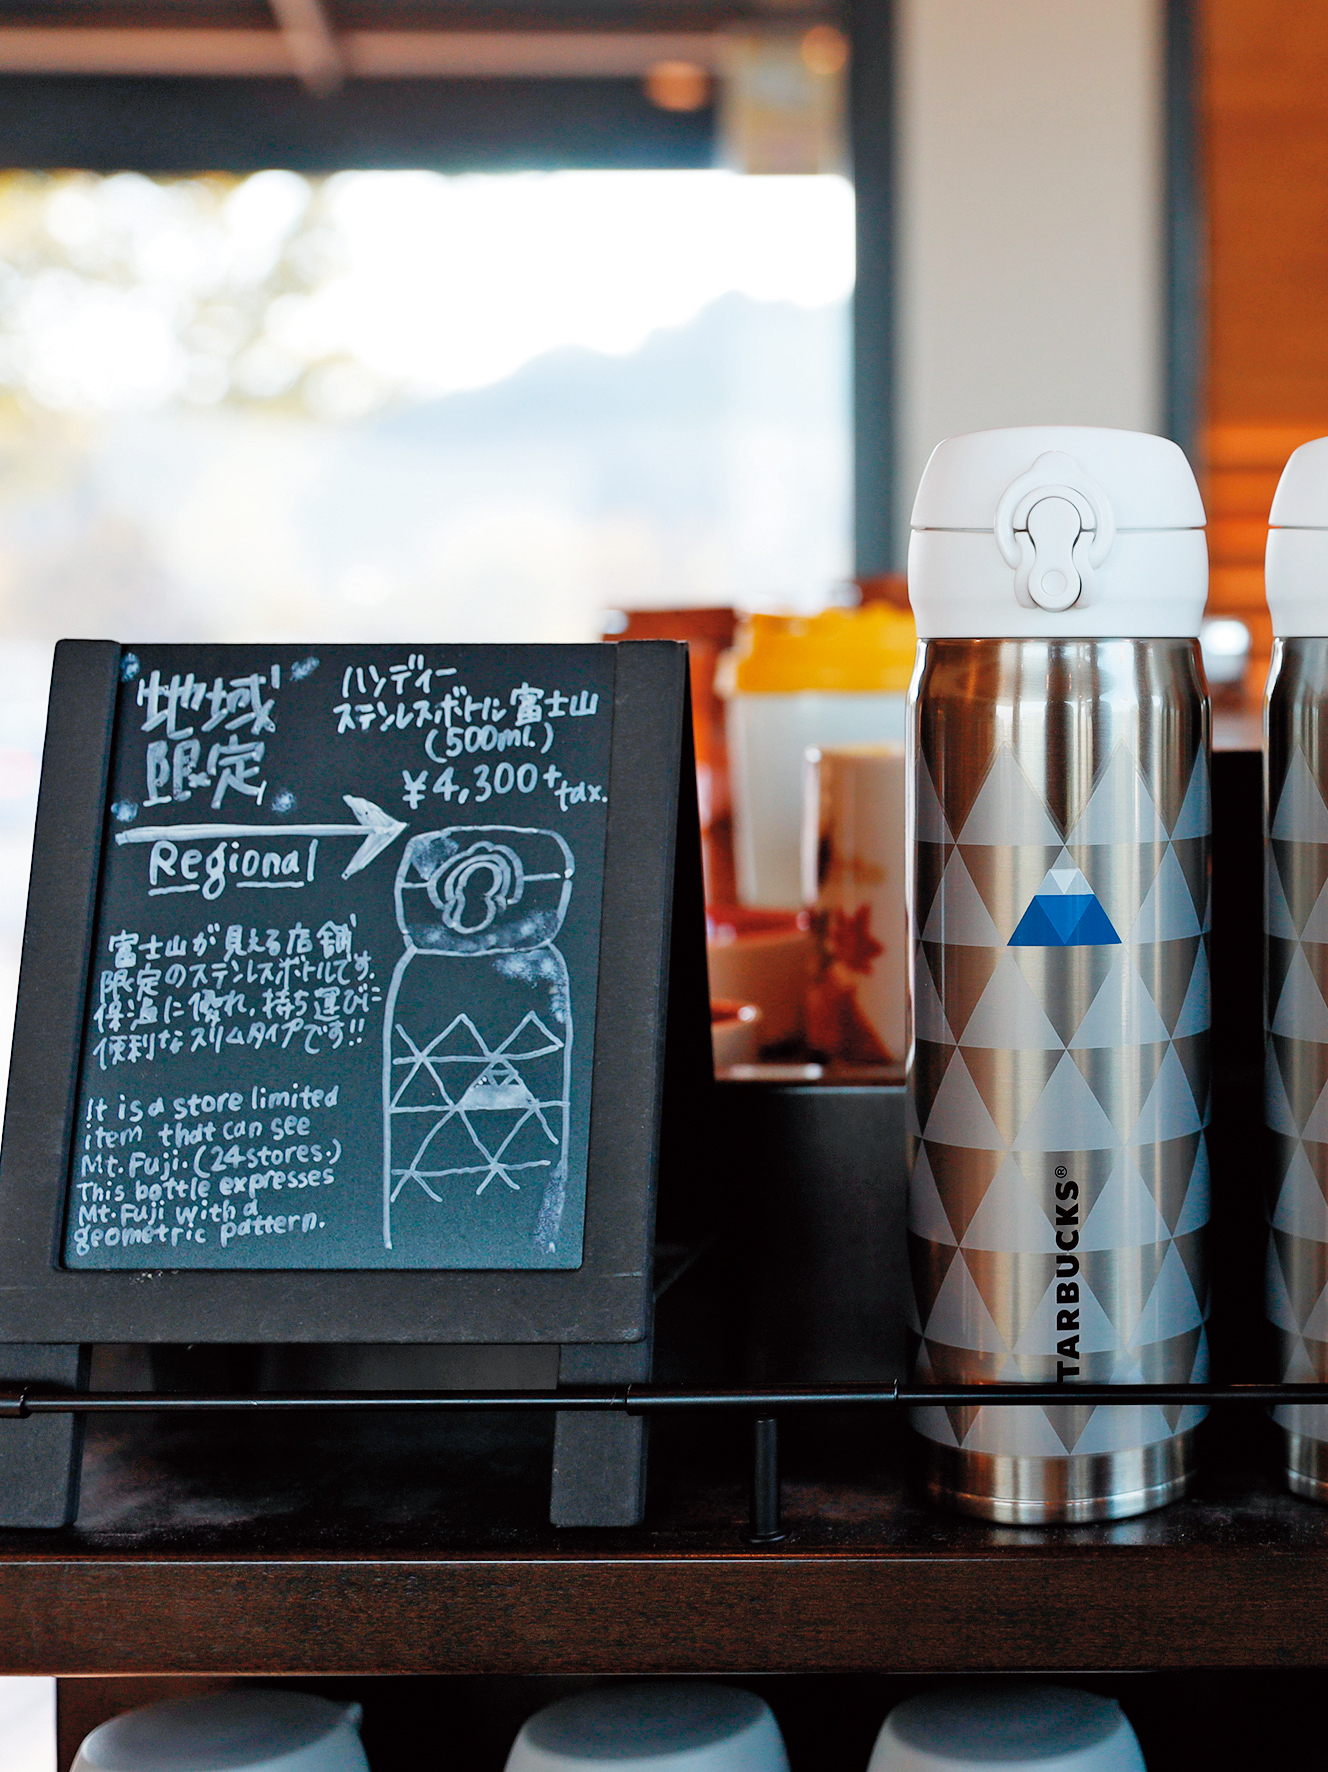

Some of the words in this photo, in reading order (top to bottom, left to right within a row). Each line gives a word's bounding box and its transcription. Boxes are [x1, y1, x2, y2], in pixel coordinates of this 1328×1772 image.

[342, 654, 457, 698] ハンディー
[137, 664, 281, 739] 地域
[143, 734, 267, 809] 限定
[149, 839, 318, 900] Regional
[85, 1097, 107, 1122] It
[173, 1092, 243, 1120] store
[252, 1083, 339, 1110] limited
[85, 1123, 143, 1150] item
[158, 1121, 217, 1148] that
[222, 1120, 262, 1141] can
[270, 1115, 310, 1141] see
[76, 1181, 125, 1202] This
[135, 1177, 211, 1201] bottle
[219, 1168, 335, 1199] expresses
[175, 1199, 236, 1225] with
[243, 1198, 259, 1217] a
[74, 1221, 206, 1257] geometric
[221, 1211, 326, 1248] pattern.
